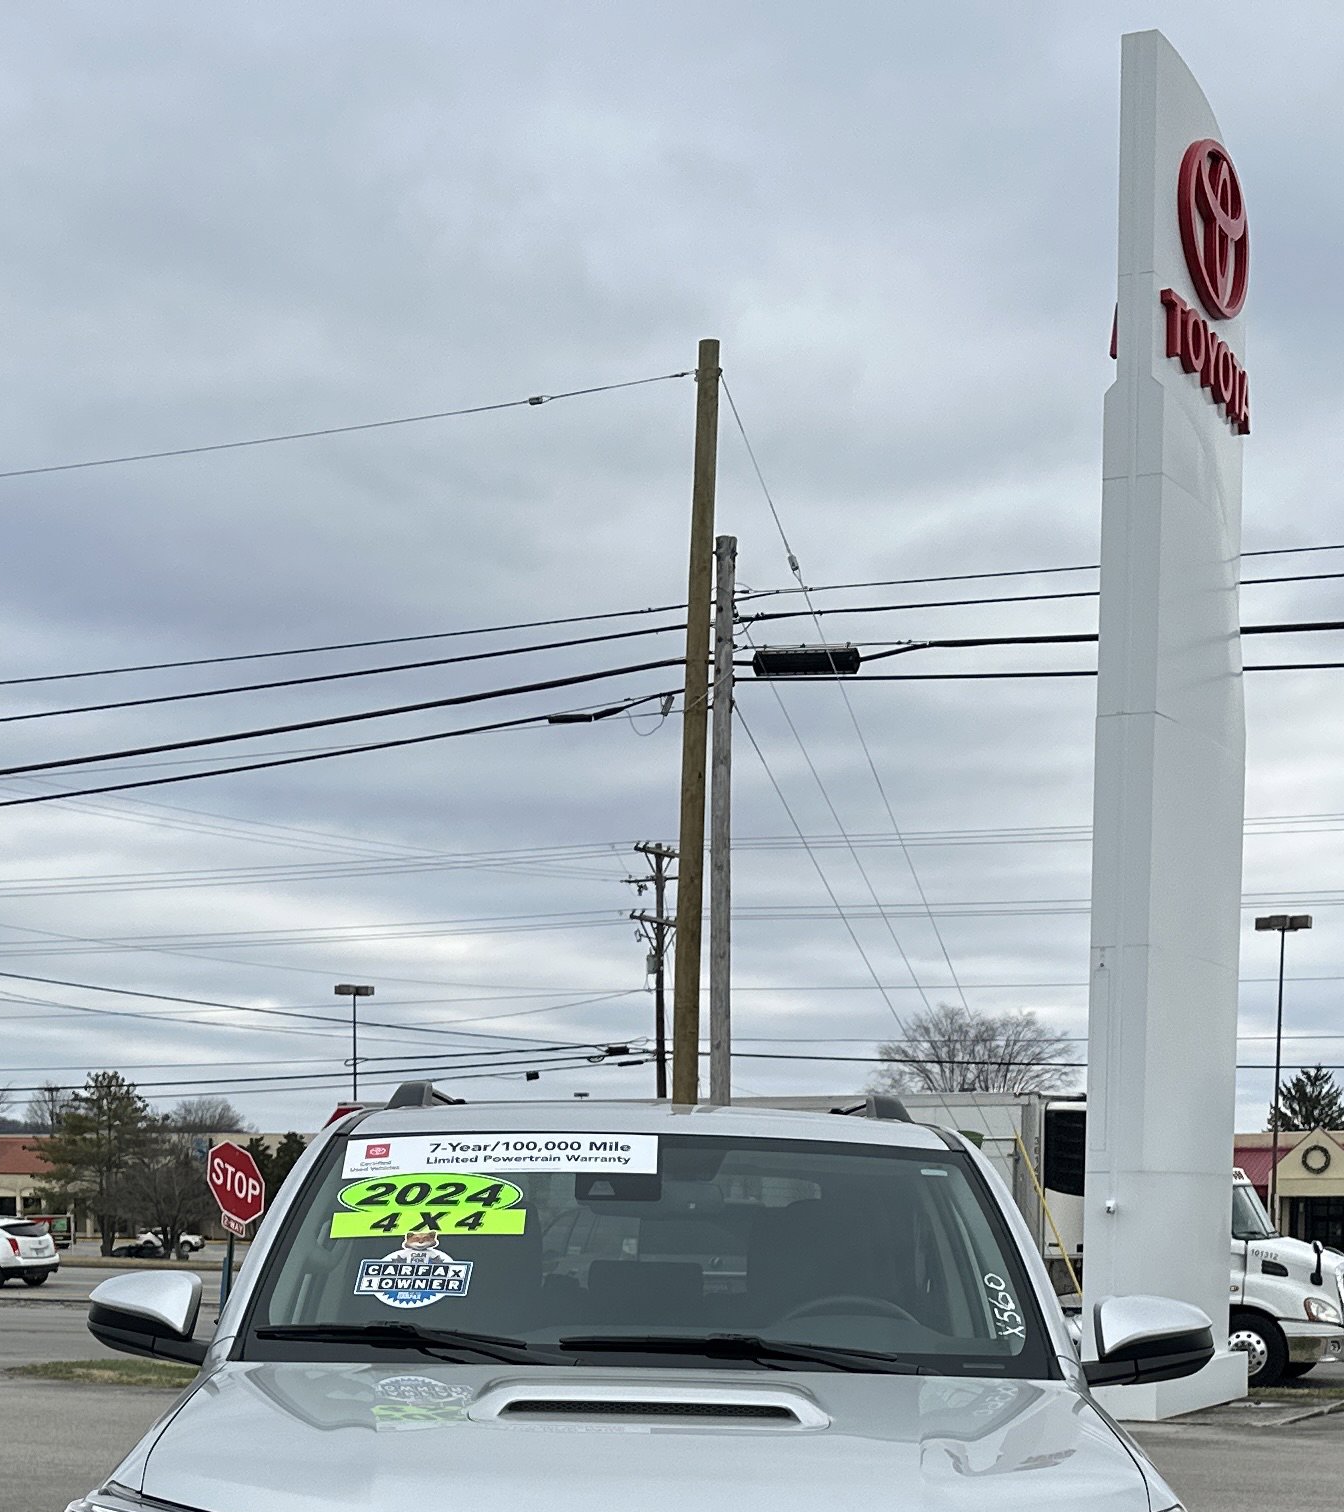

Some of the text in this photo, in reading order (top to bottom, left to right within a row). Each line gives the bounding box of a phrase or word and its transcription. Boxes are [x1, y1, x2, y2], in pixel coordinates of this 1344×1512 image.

[1160, 288, 1250, 435] TOYOTA
[429, 1141, 632, 1153] 7-Year/100,000 Mile
[426, 1154, 632, 1165] Limited Powertrain Warranty
[211, 1158, 260, 1204] STOP
[355, 1182, 505, 1207] 2024
[366, 1264, 463, 1278] CARFAX
[381, 1279, 460, 1291] OWNER
